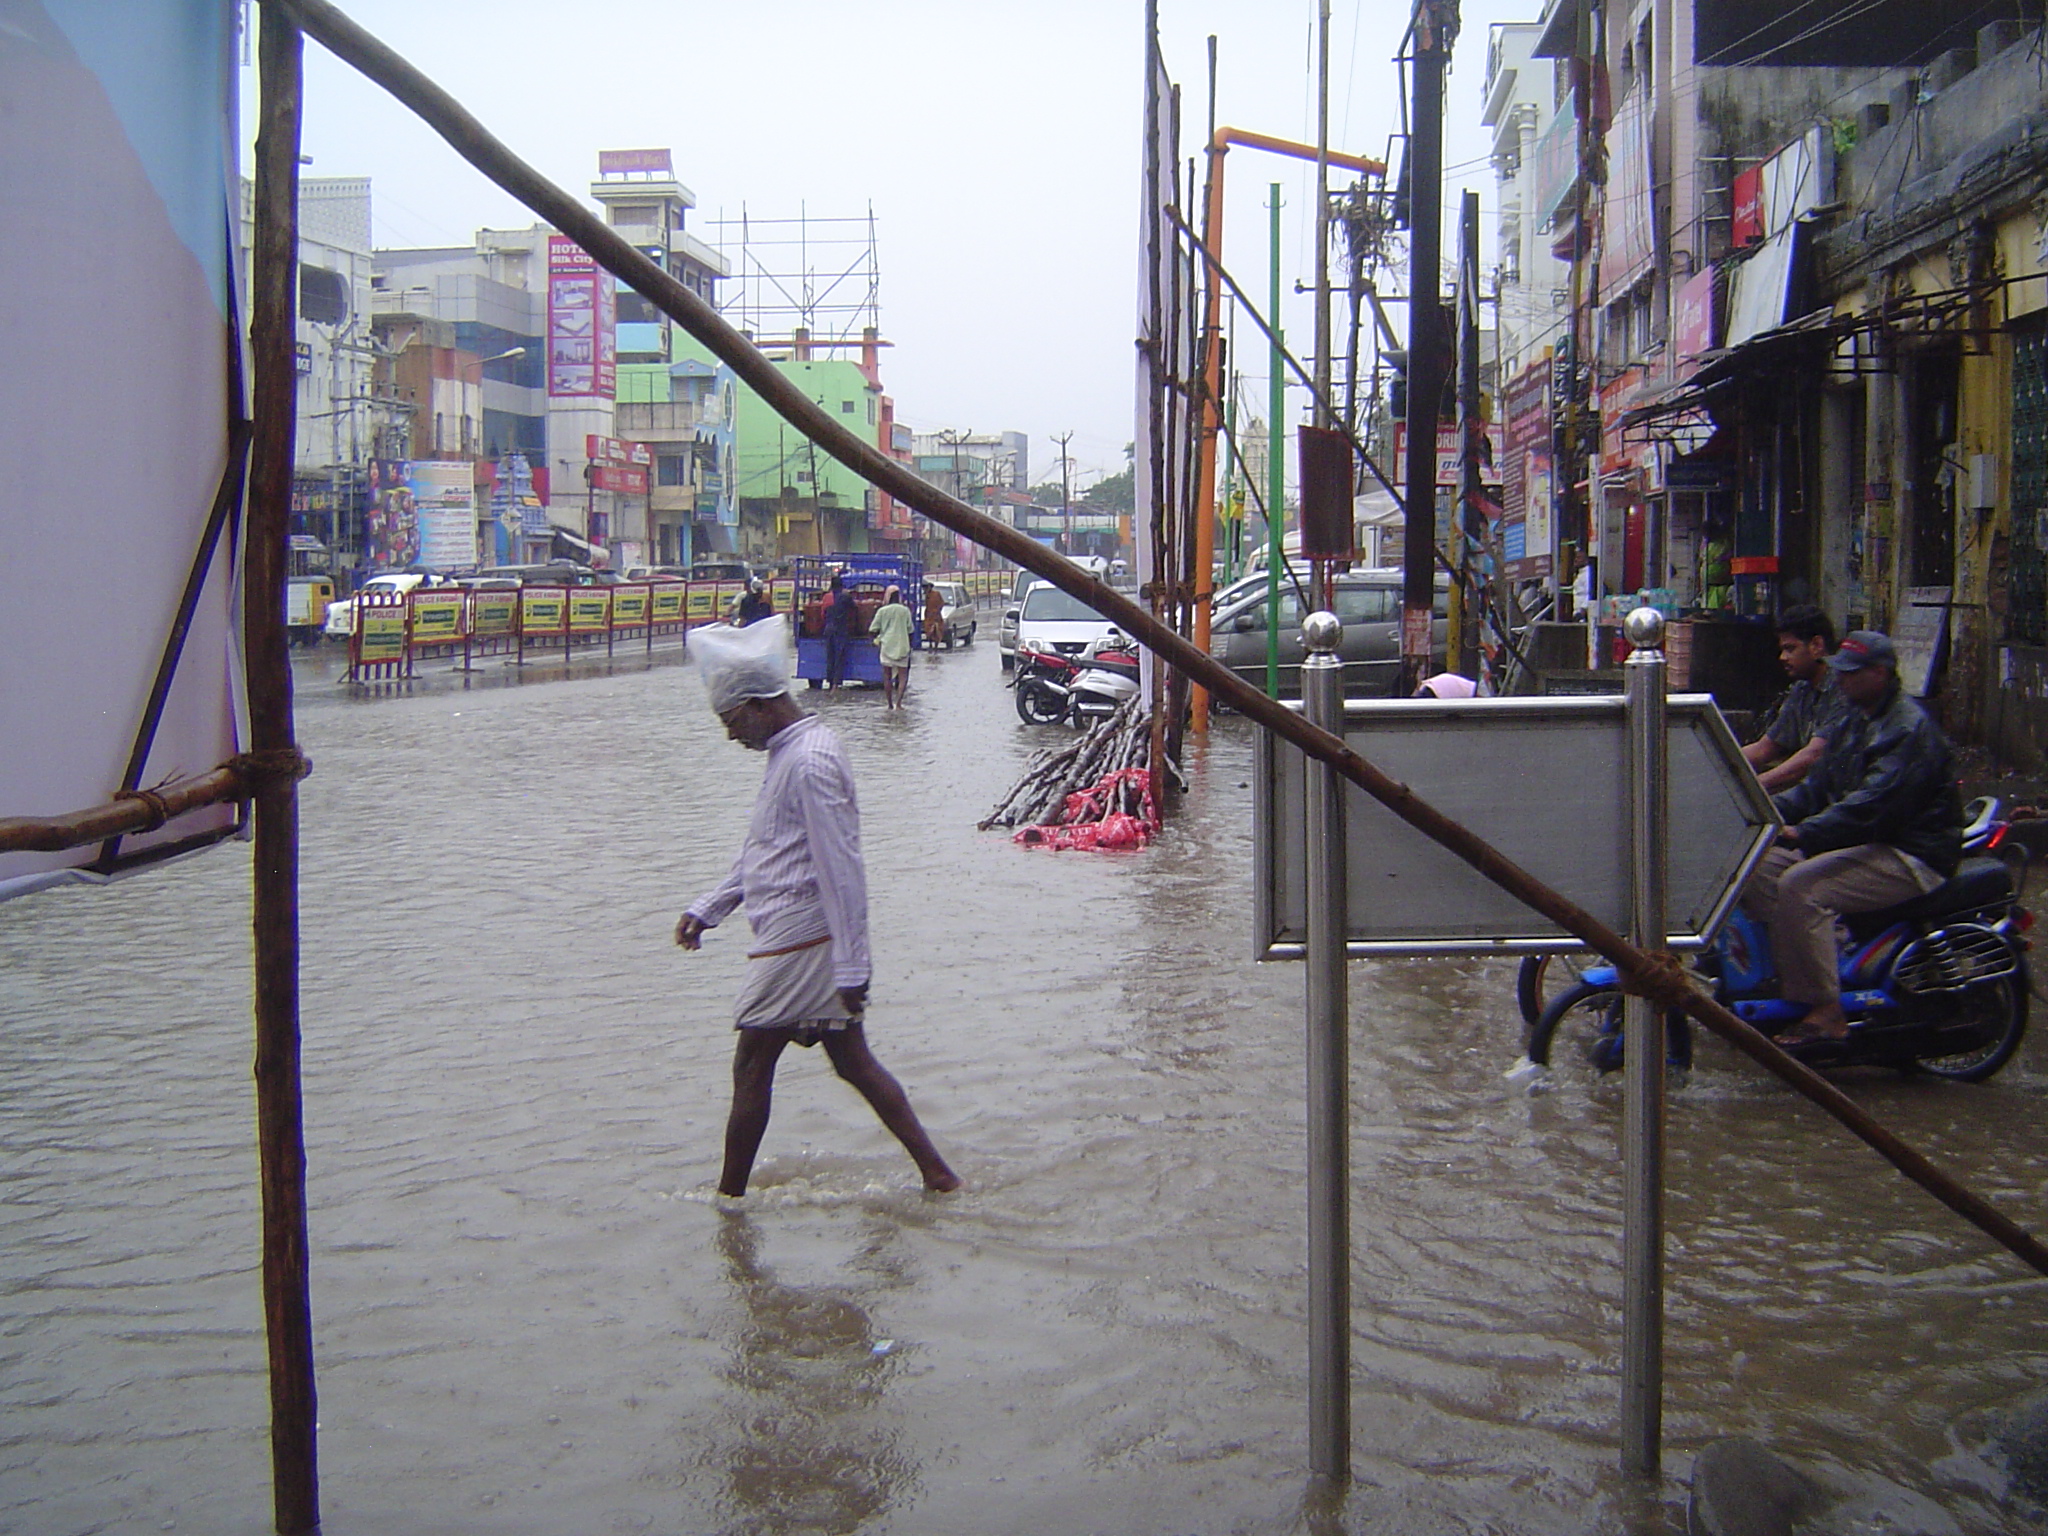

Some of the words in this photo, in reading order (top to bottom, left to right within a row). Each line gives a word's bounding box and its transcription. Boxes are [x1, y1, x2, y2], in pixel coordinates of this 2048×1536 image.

[551, 244, 586, 254] HOT
[551, 255, 572, 264] Silk
[573, 255, 594, 265] City
[371, 609, 397, 619] POLICE
